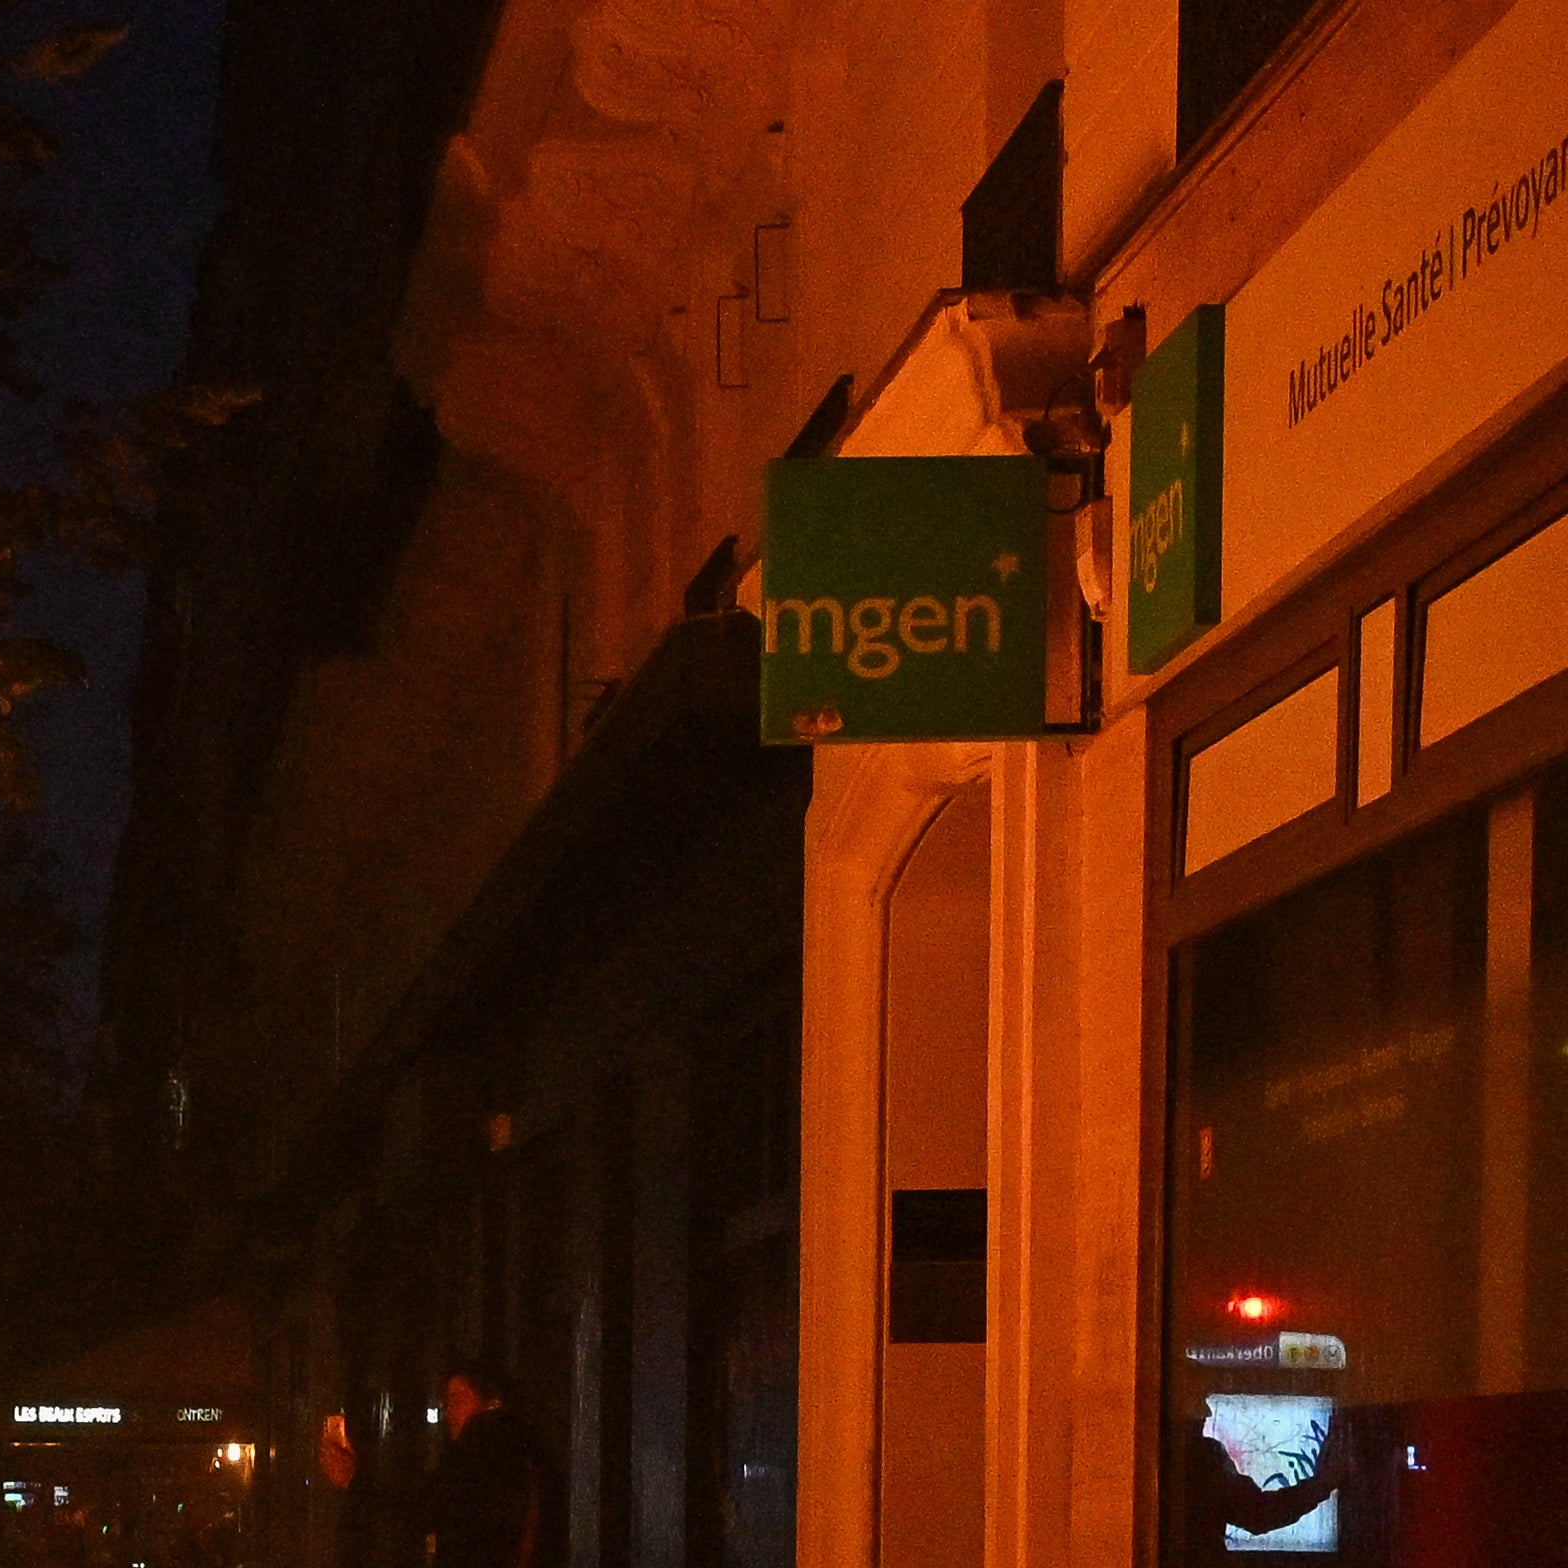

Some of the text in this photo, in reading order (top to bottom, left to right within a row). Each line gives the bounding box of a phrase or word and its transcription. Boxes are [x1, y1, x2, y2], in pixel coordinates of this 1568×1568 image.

[1288, 303, 1376, 429] Mutuelle
[1380, 230, 1443, 346] Santé
[1131, 479, 1183, 593] mgen
[765, 595, 1002, 680] mgen
